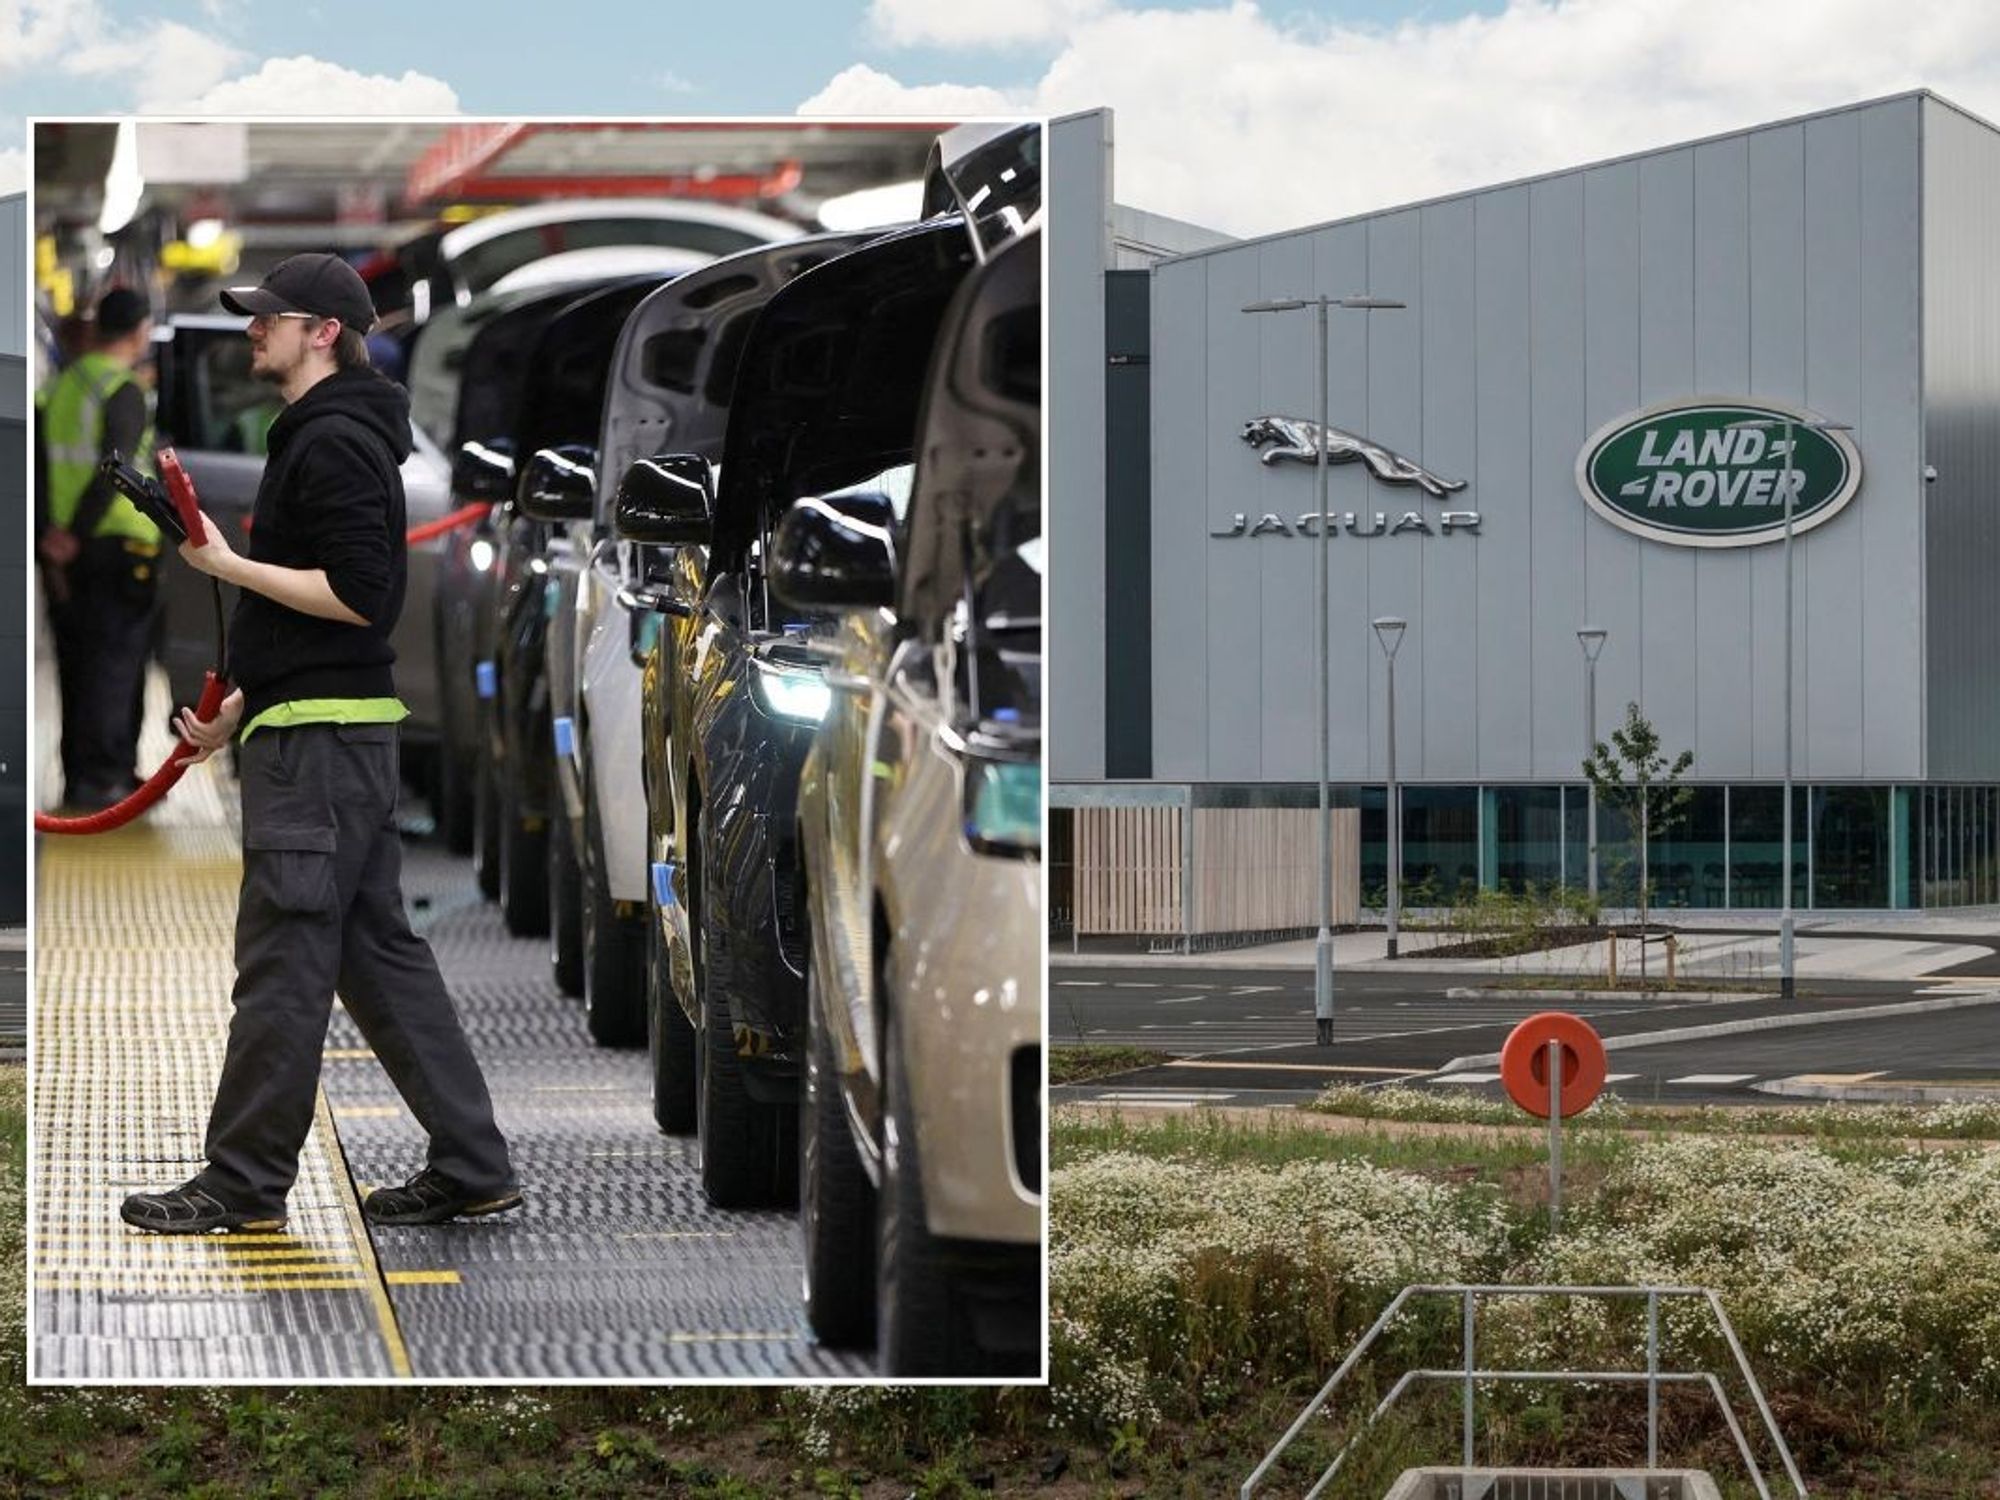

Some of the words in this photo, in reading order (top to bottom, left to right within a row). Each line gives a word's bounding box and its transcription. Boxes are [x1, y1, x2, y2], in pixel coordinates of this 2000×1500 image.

[1636, 428, 1767, 466] LAND
[1647, 468, 1807, 507] ROVER
[1210, 511, 1482, 539] JAGUAR
